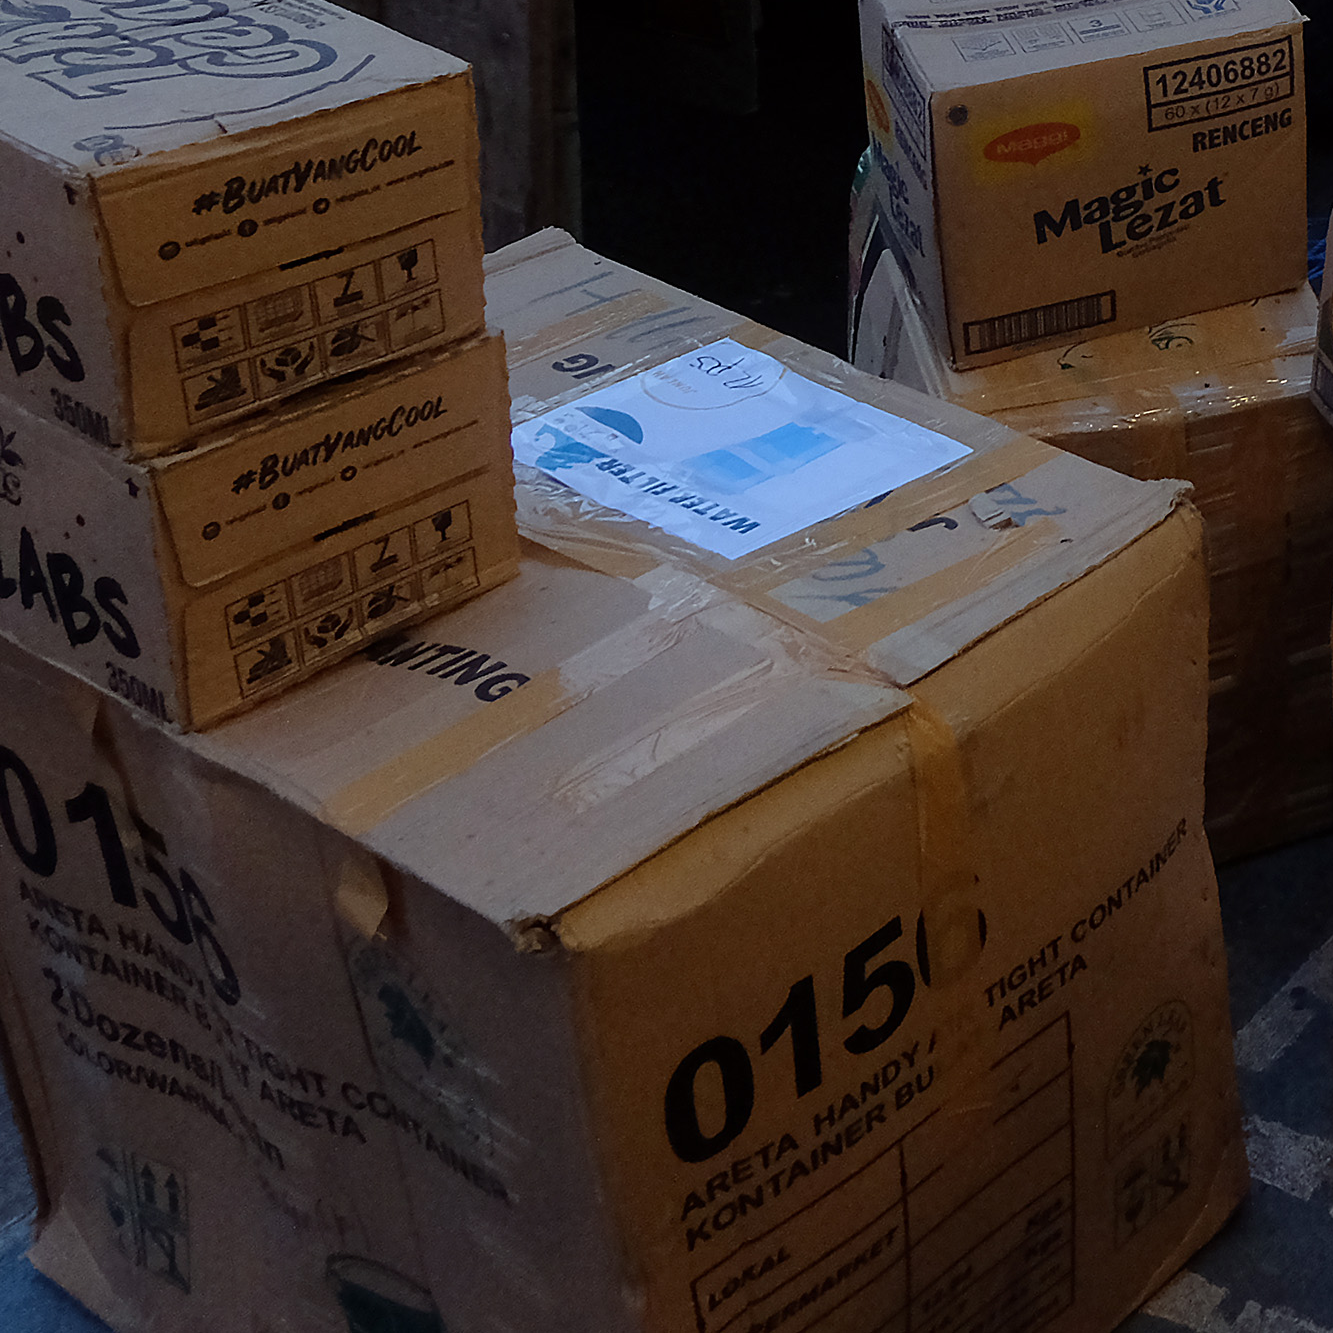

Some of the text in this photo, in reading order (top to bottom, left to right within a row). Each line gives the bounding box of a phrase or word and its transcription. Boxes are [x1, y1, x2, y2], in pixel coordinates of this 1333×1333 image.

[1156, 48, 1287, 98] 12406882
[1165, 105, 1186, 121] 60
[1205, 94, 1231, 114] (12
[1192, 108, 1292, 153] RENCENG
[1033, 165, 1180, 245] Magic
[1099, 177, 1226, 254] Lezat
[50, 385, 120, 448] 350ML
[668, 495, 761, 534] WATER
[107, 662, 169, 723] 350ML
[664, 876, 988, 1166] 015
[681, 818, 1189, 1221] ARETA HANDY TIGHT CONTAINER
[260, 1080, 367, 1144] ARETA
[684, 1102, 887, 1253] KONTAINER
[998, 954, 1089, 1031] ARETA
[706, 1243, 792, 1312] LOKAL
